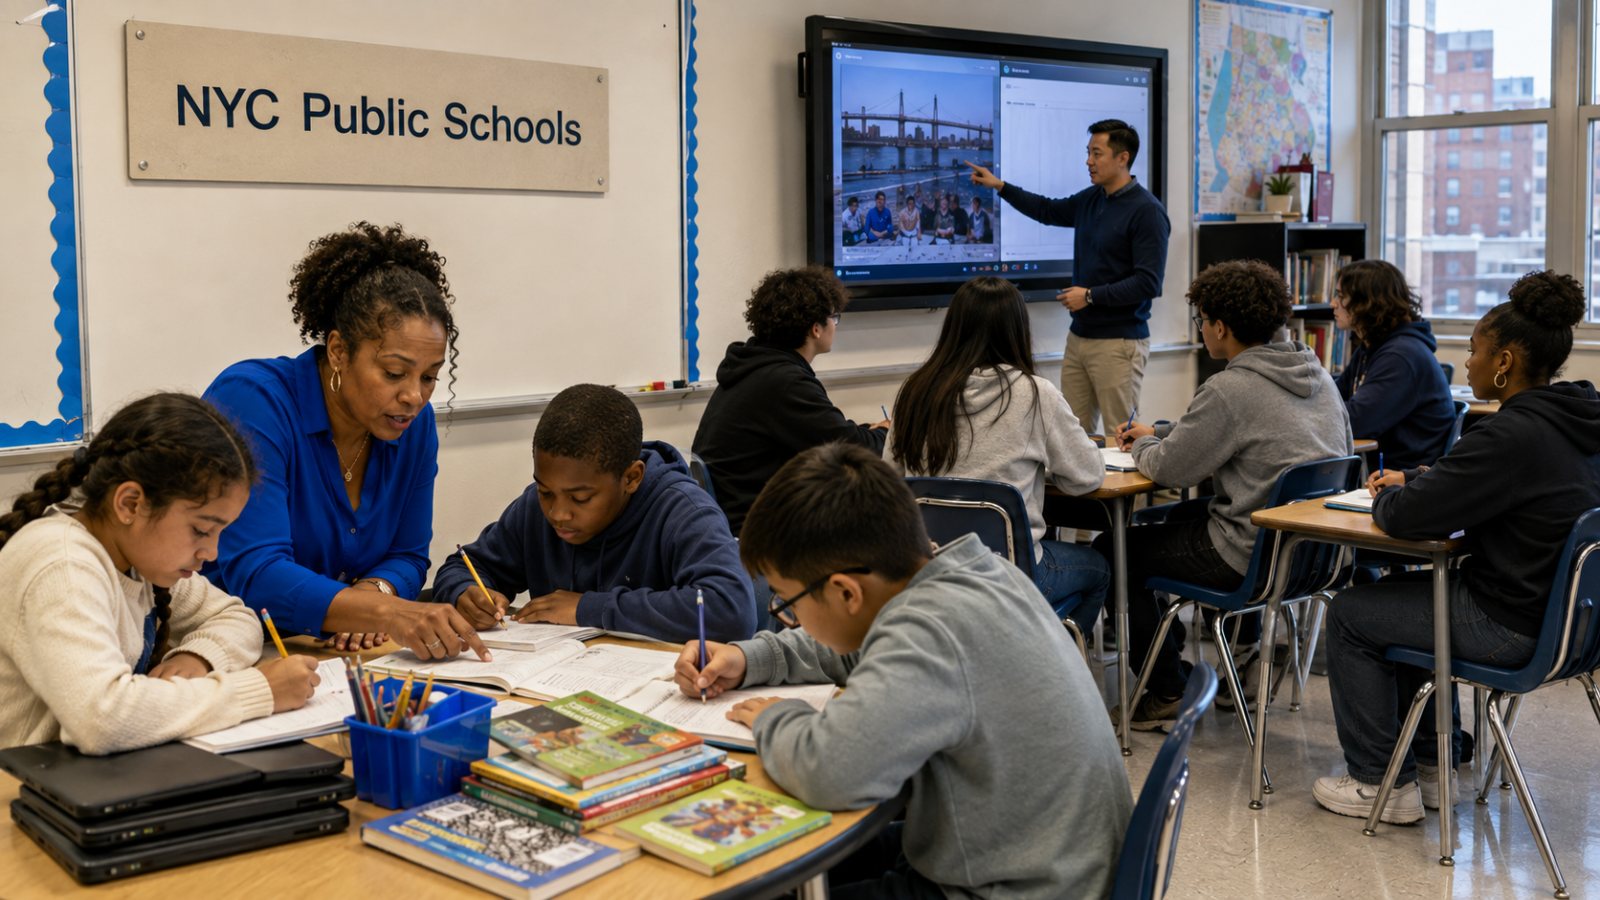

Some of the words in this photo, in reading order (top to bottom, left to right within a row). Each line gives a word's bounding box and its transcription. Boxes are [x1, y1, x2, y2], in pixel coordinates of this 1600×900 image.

[176, 84, 279, 131] NYC
[304, 92, 429, 138] Public
[444, 102, 582, 146] Schools
